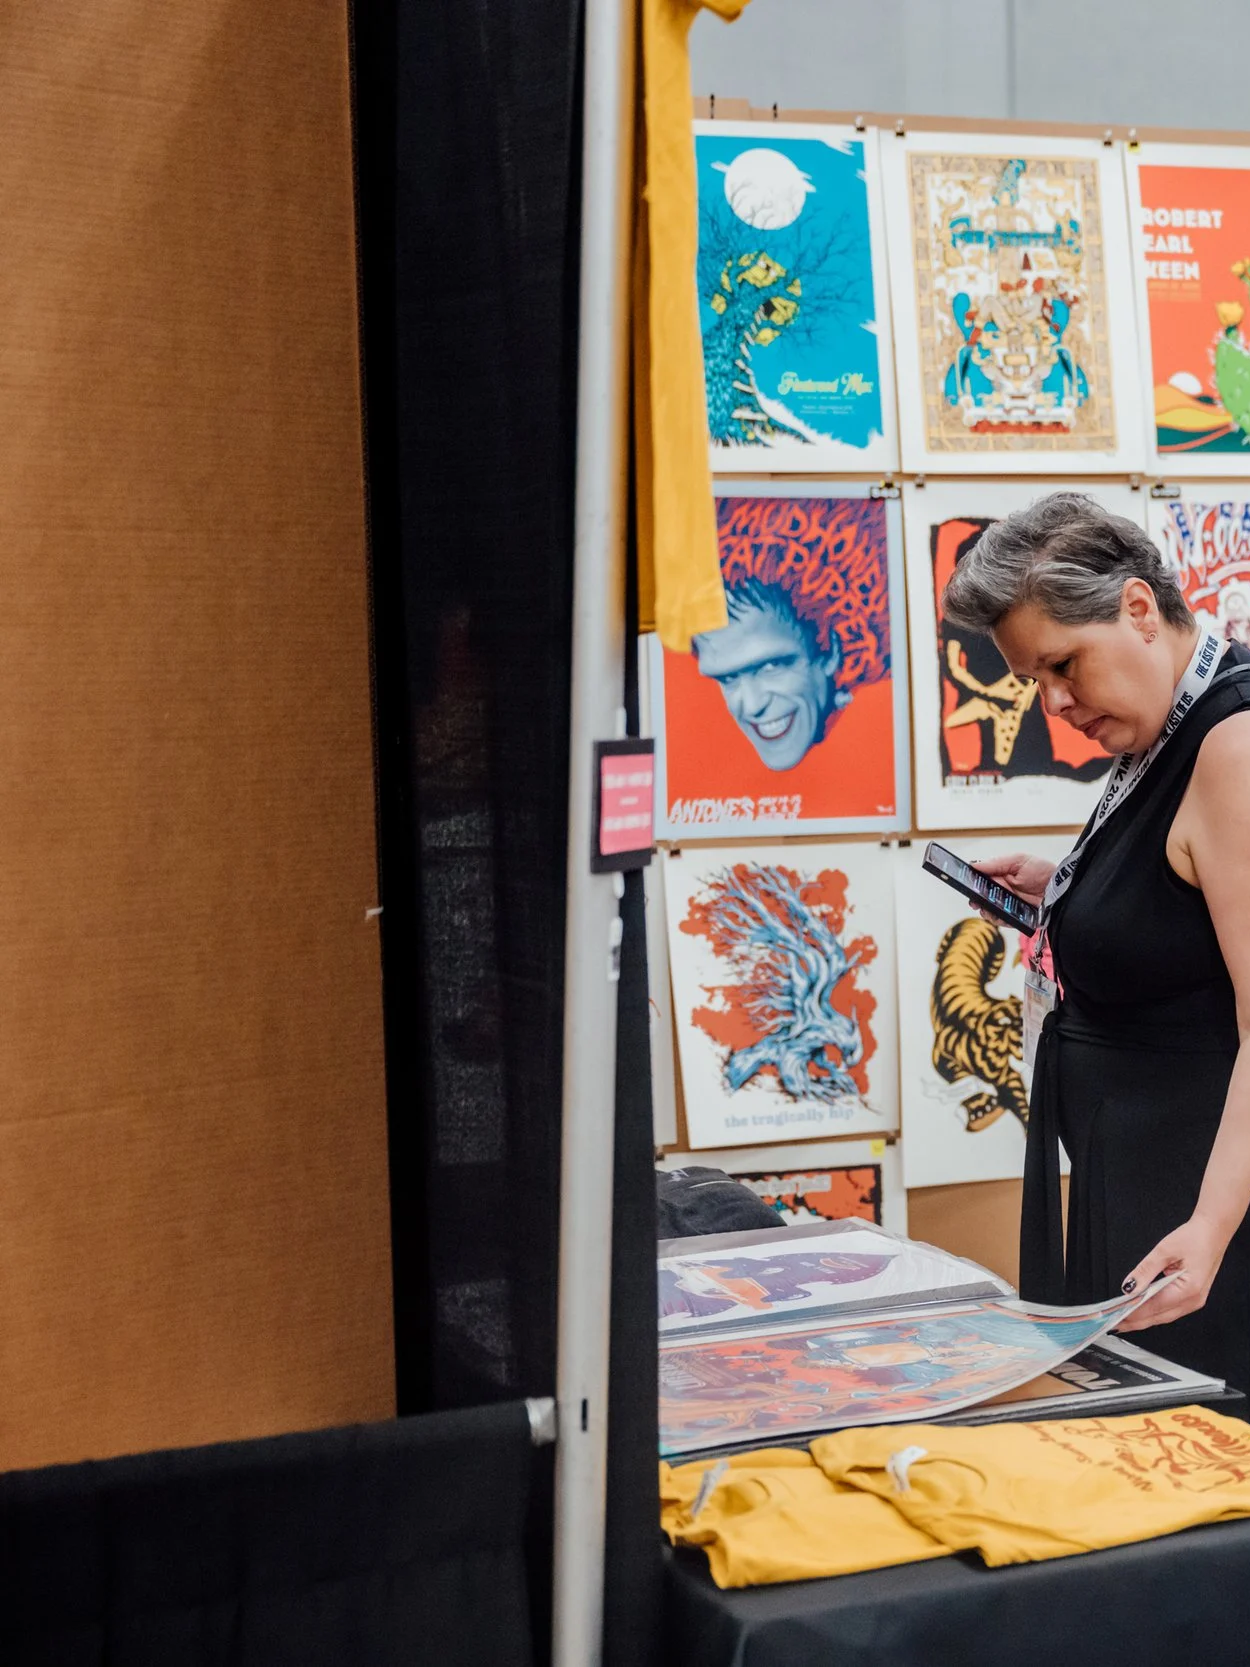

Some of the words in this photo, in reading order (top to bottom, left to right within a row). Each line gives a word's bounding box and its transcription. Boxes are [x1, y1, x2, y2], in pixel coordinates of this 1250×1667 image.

[1200, 647, 1216, 668] LAST
[1195, 662, 1210, 679] THE
[1165, 708, 1183, 732] LAST
